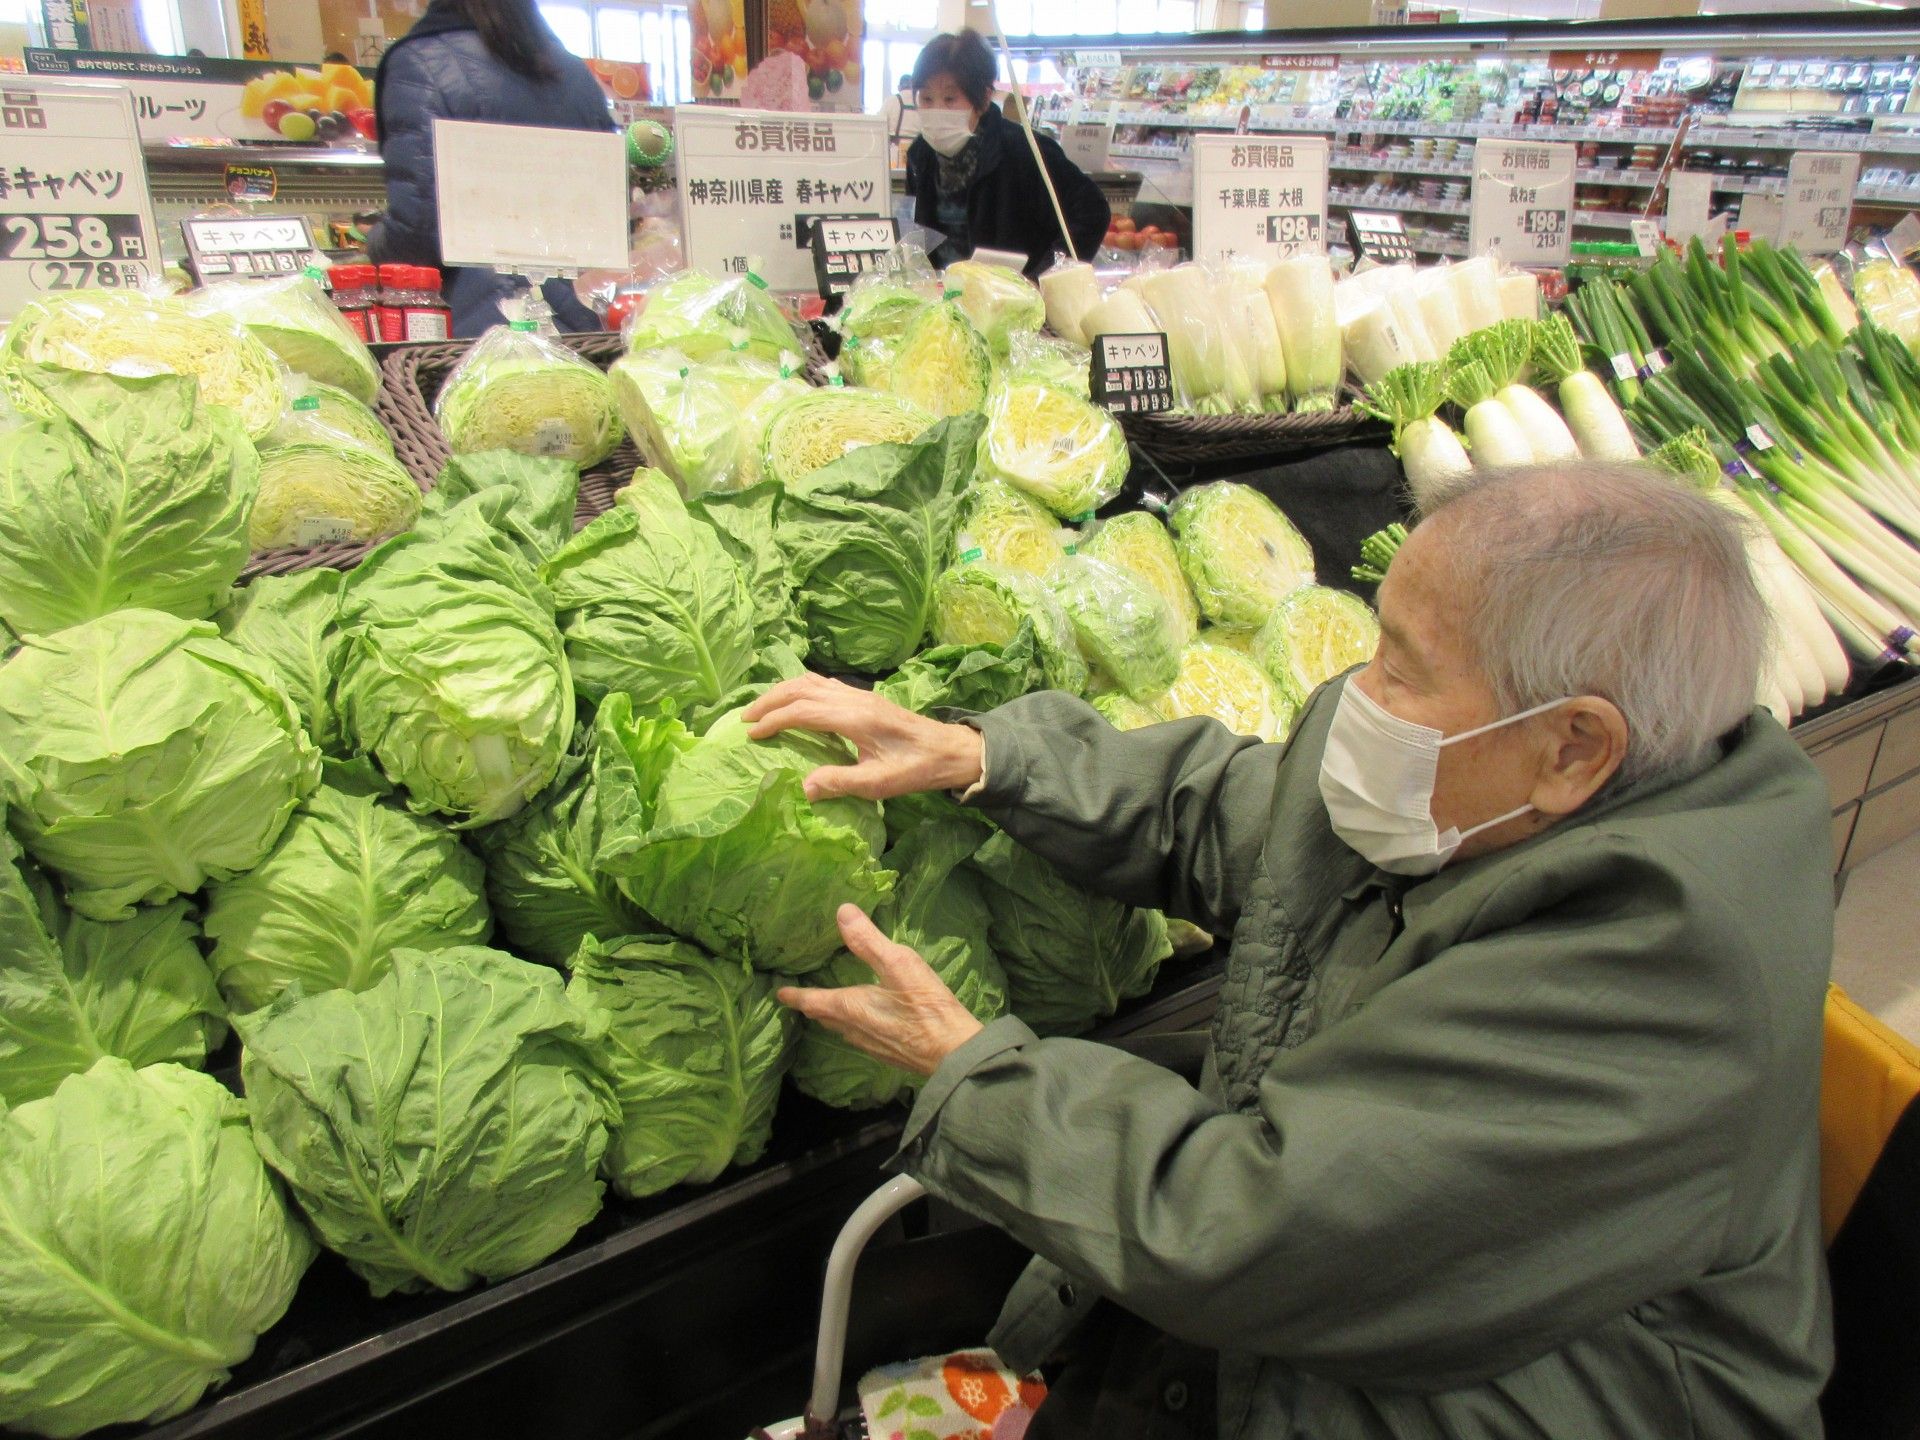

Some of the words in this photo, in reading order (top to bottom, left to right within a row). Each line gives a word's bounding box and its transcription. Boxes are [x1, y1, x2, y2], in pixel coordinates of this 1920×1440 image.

[1585, 52, 1619, 65] キムチ
[134, 96, 207, 121] ルーツ
[734, 121, 836, 152] お買得品
[1231, 145, 1294, 168] お買得品
[1501, 149, 1551, 169] お買得品
[229, 166, 272, 177] チョコバナナ
[689, 178, 784, 205] 神奈川県産
[796, 178, 874, 205] 春キャベツ
[1219, 188, 1270, 209] 千葉県産
[1279, 187, 1304, 208] 大根
[202, 228, 296, 245] キャベツ
[828, 228, 889, 245] キャベツ
[1135, 371, 1165, 387] 138
